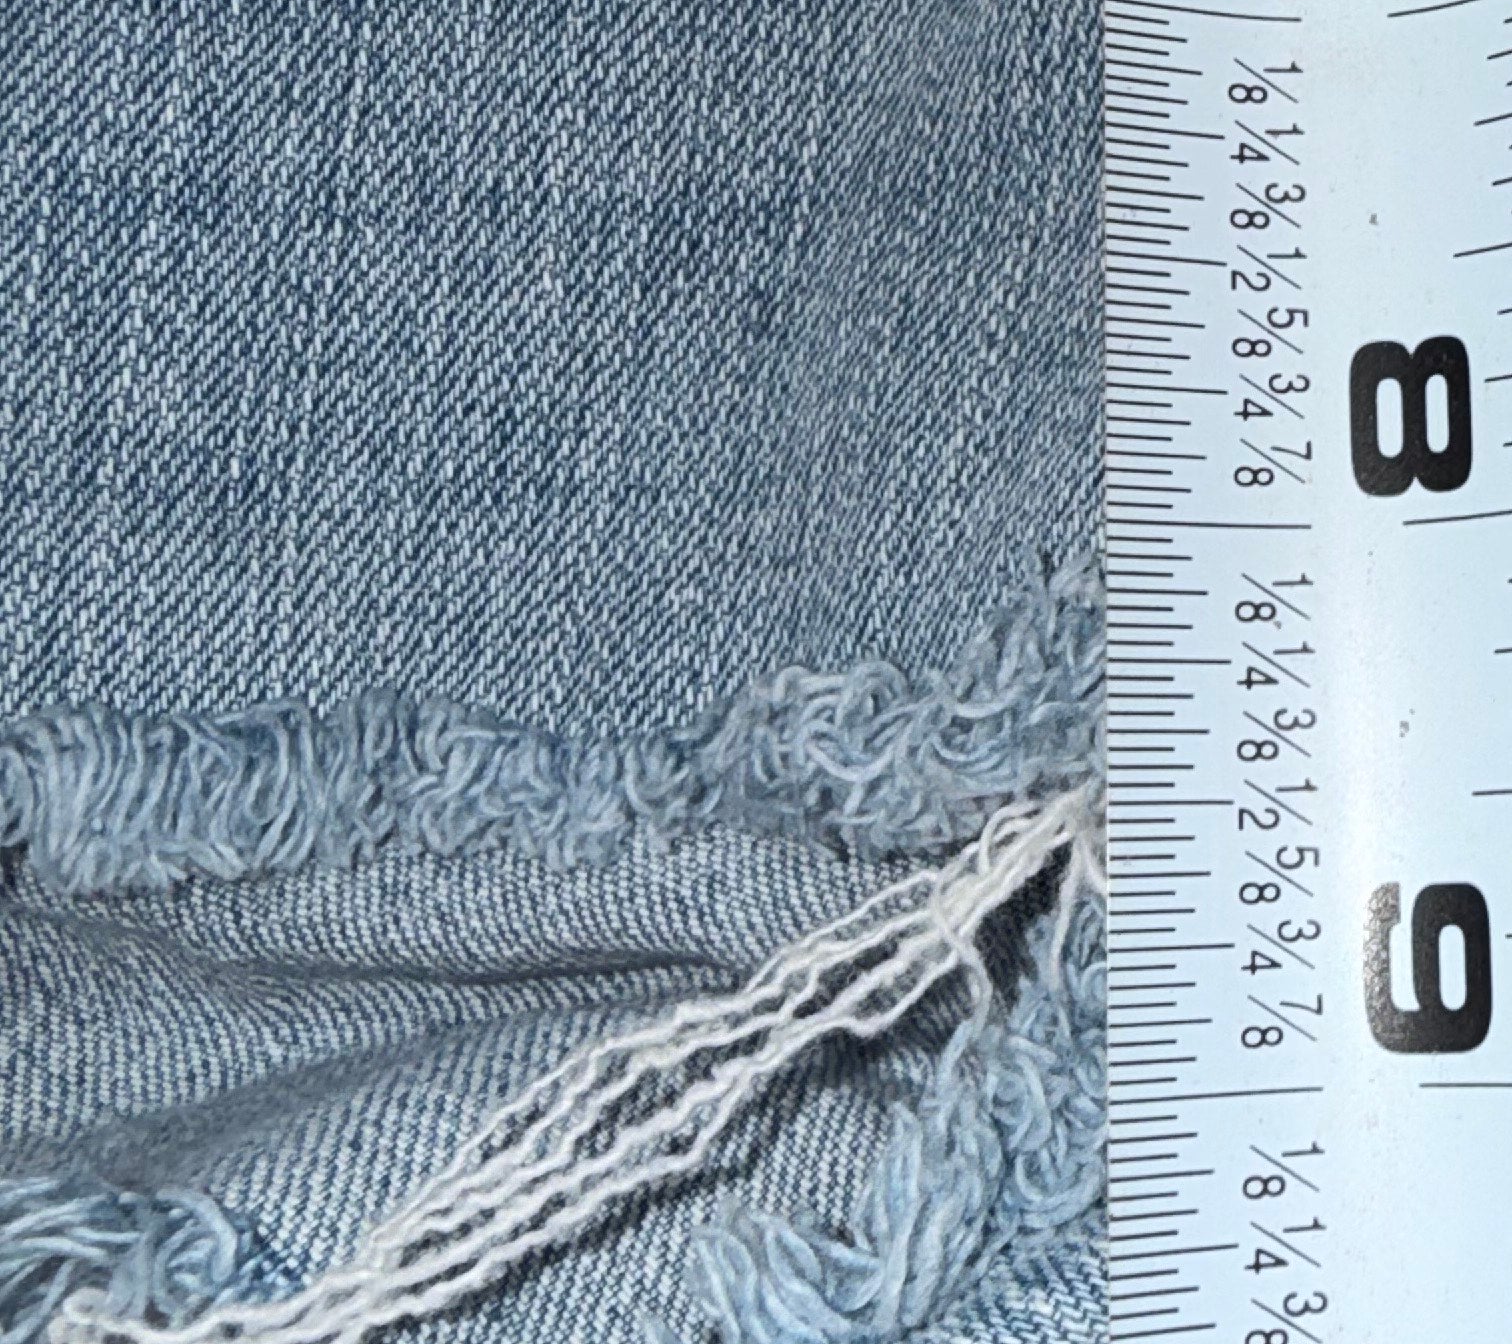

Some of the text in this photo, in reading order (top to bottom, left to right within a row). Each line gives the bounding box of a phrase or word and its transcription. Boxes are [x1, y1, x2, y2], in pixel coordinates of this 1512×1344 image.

[1226, 56, 1314, 488] 1/8 1/4 3/8 1/2 5/8 3/4 7/8
[1349, 335, 1473, 498] 8
[1234, 572, 1324, 1050] 1/8 1/4 3/8 1/2 5/8 3/4 7/8
[1362, 881, 1493, 1055] 9
[1241, 1140, 1326, 1201] 1/8
[1243, 1215, 1328, 1276] 1/4
